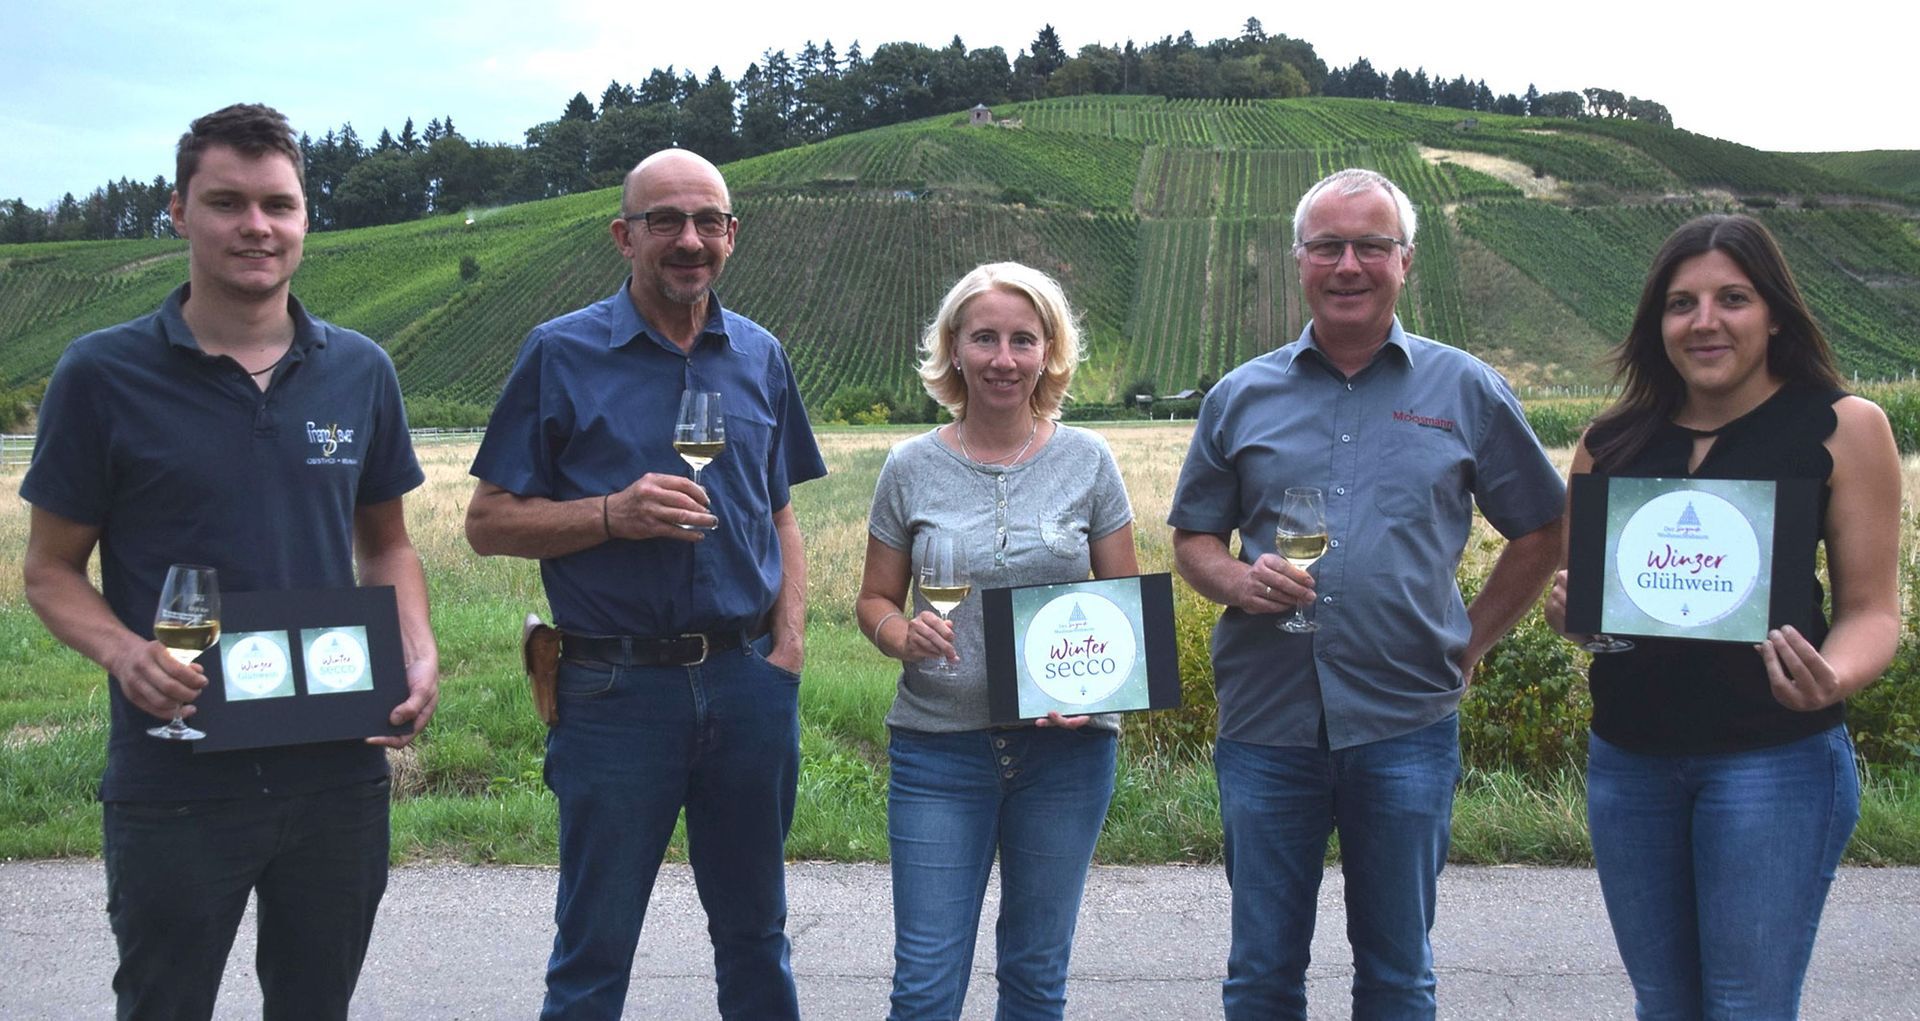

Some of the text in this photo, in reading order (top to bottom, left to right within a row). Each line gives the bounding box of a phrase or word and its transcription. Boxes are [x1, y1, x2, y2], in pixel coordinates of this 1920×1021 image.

[1647, 544, 1728, 574] Winzer
[1637, 572, 1734, 592] Glühwein
[1050, 635, 1109, 659] Winter
[1045, 658, 1115, 679] secco
